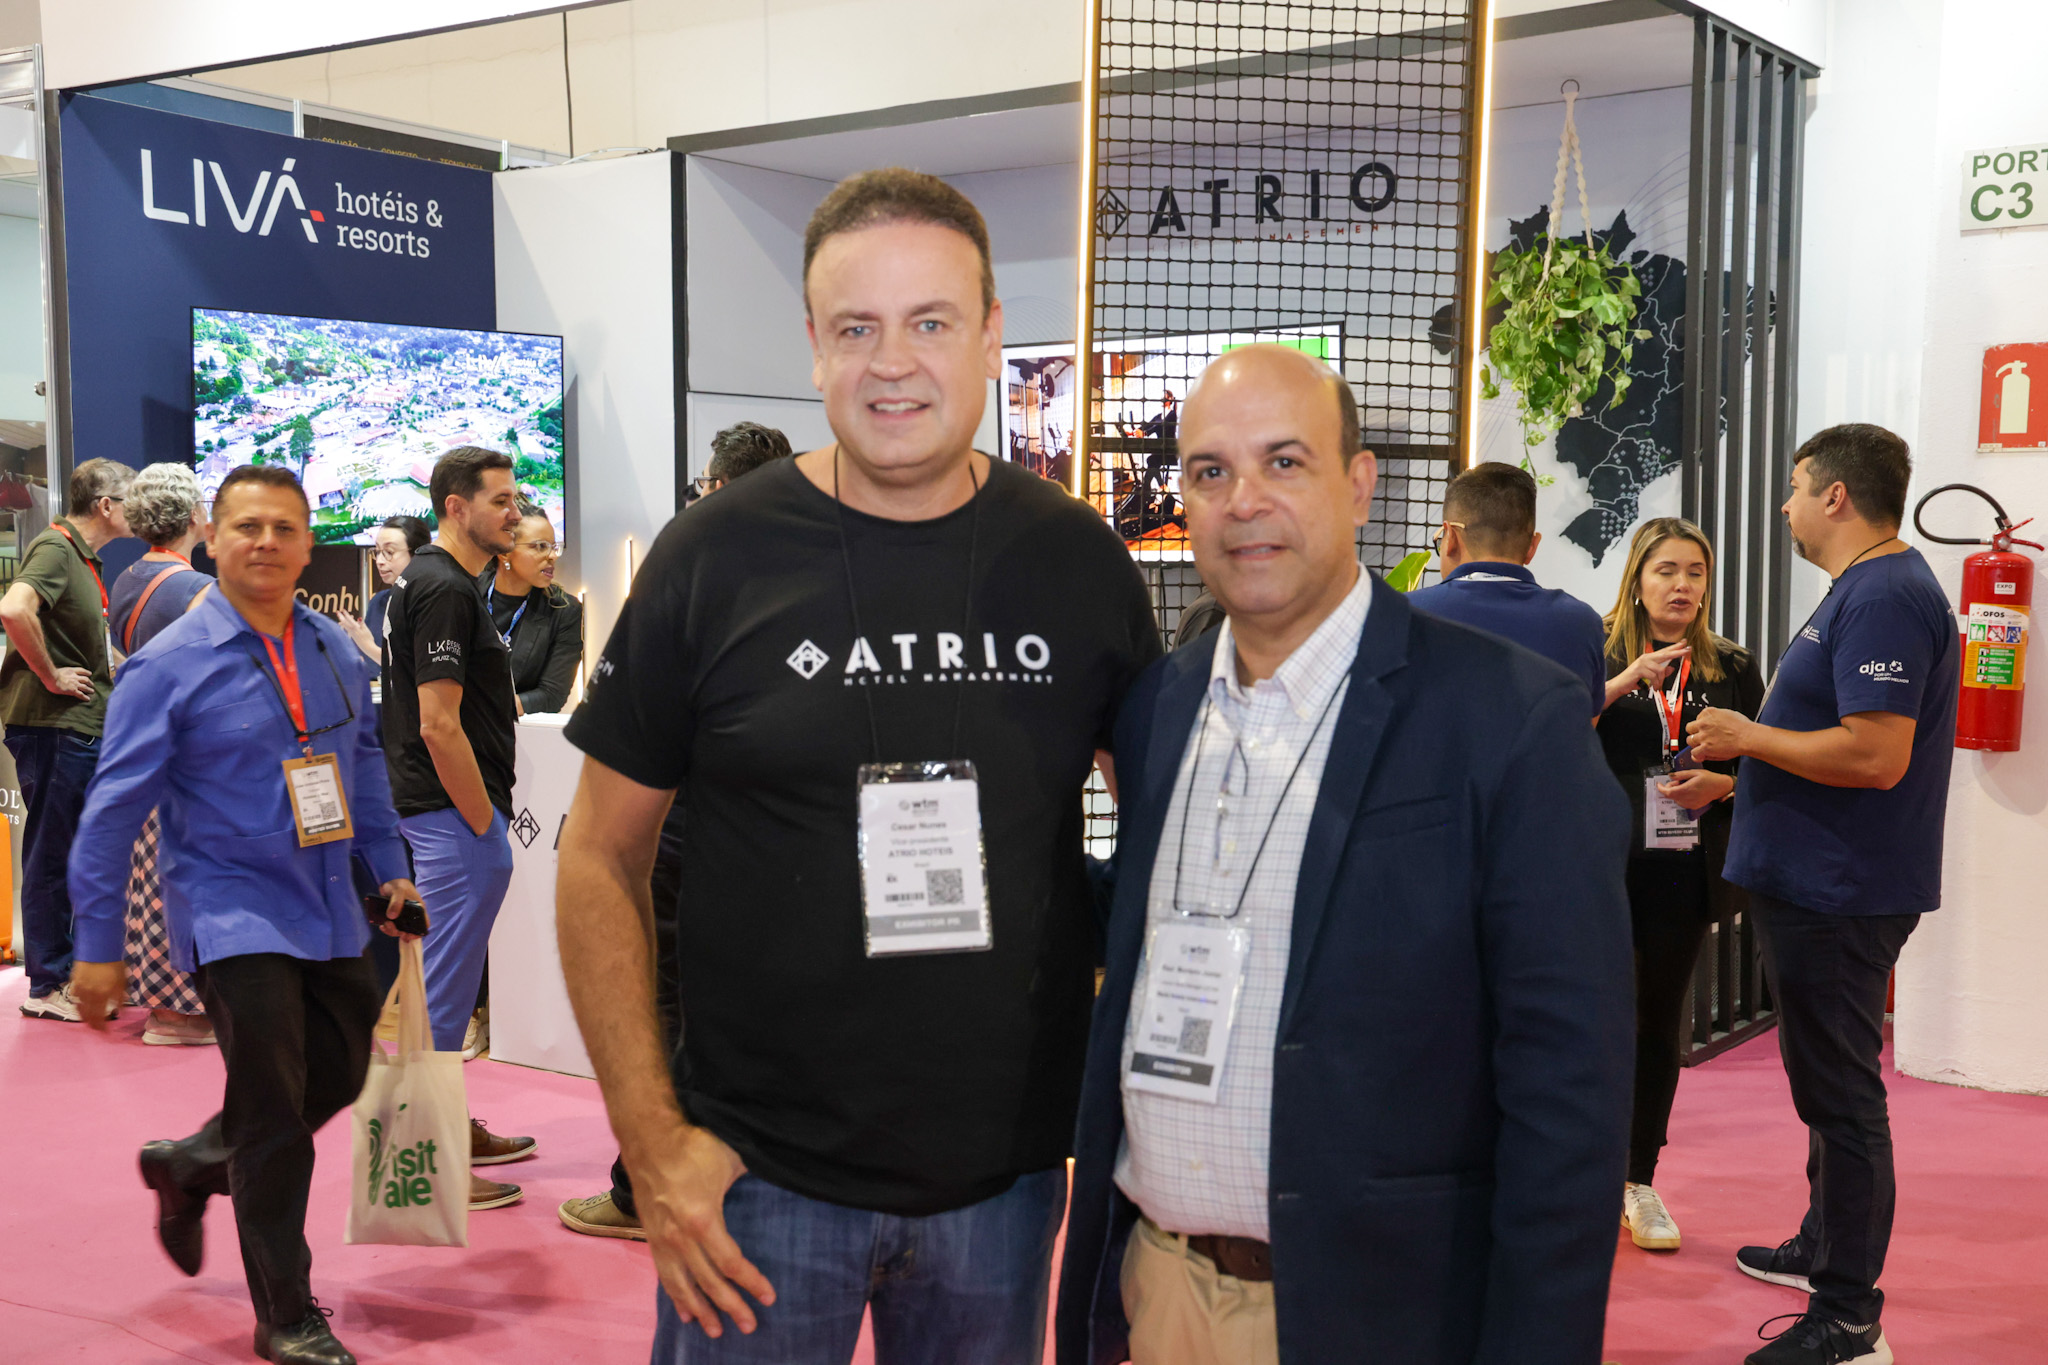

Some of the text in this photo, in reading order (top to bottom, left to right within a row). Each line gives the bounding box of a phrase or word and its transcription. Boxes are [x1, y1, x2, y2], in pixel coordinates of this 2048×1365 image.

[140, 148, 325, 244] LIVÁ
[335, 182, 443, 228] hotéis &
[1150, 162, 1396, 235] ATRIO
[1970, 182, 2033, 222] C3
[337, 225, 430, 258] resorts
[844, 632, 1051, 674] ATRIO
[1859, 660, 1886, 675] aja
[844, 672, 1053, 686] HOTEL MANAGEMENT
